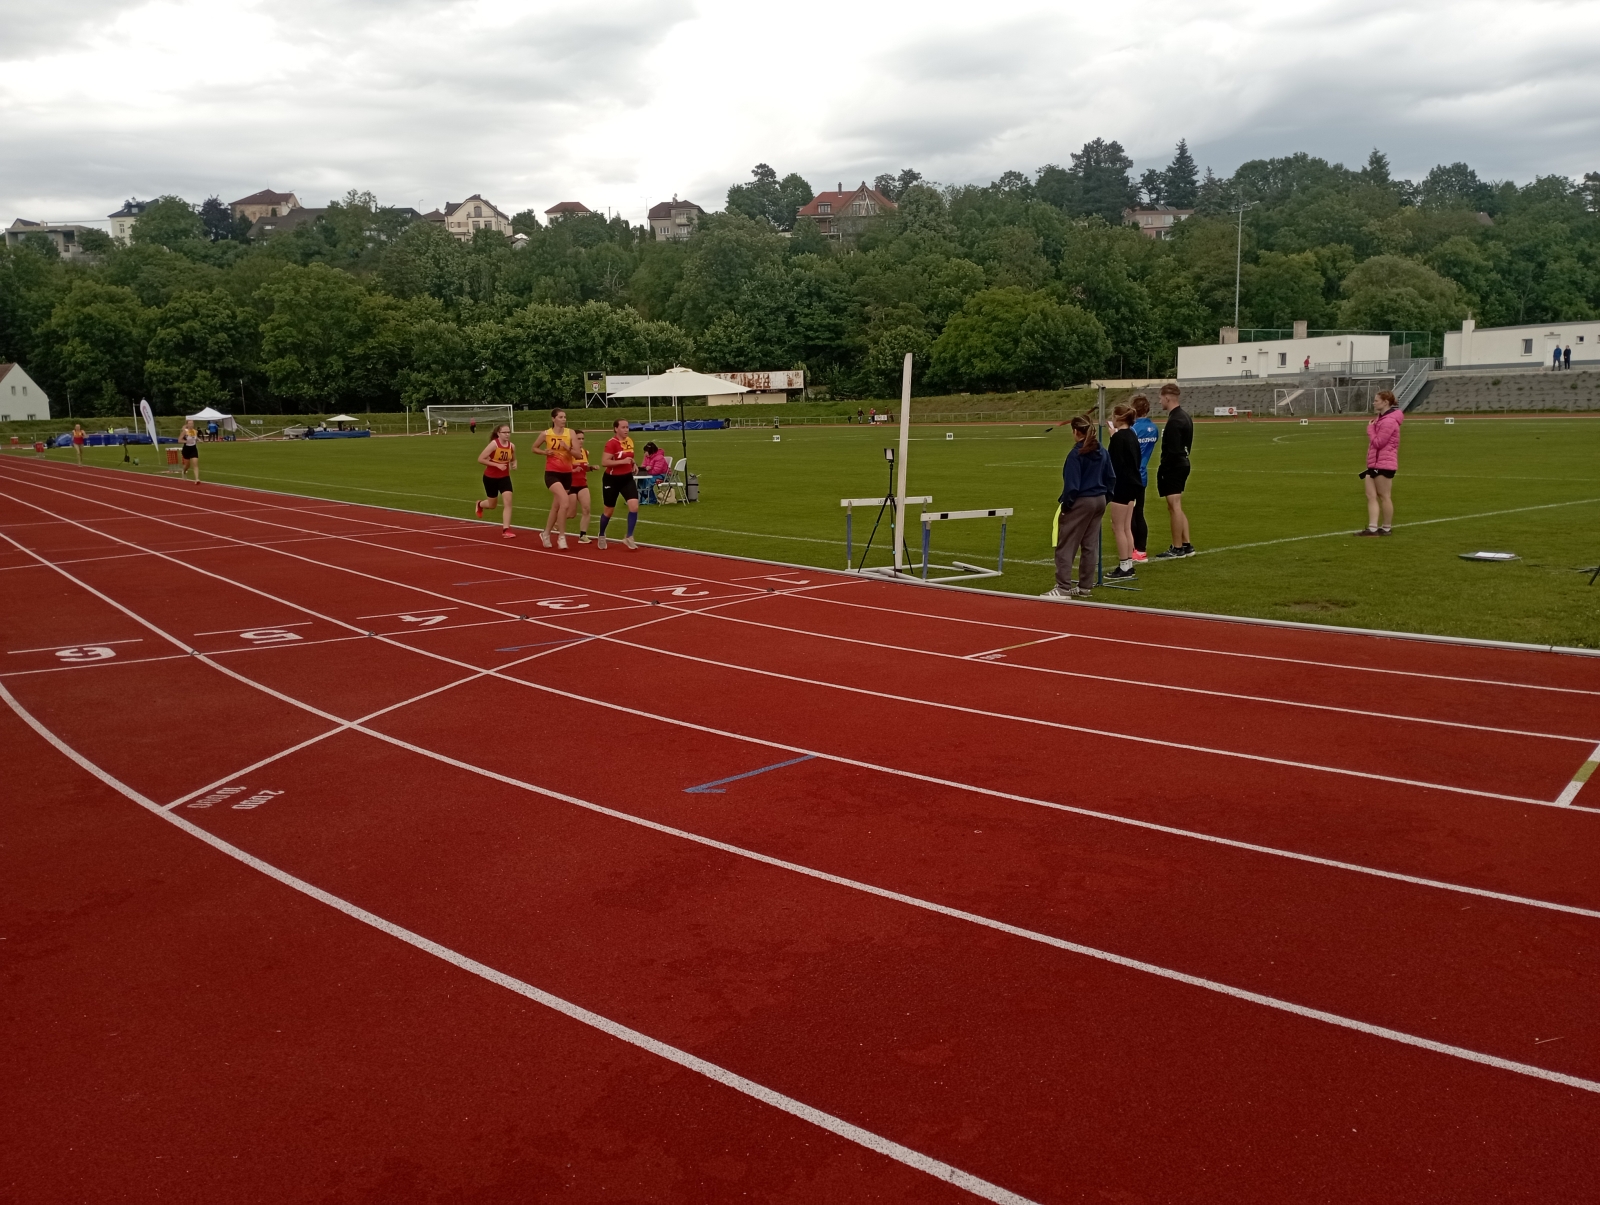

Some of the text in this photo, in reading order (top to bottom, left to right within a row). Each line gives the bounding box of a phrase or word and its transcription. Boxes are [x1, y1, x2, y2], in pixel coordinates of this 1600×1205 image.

[499, 450, 509, 461] 30
[765, 577, 811, 585] 1
[651, 586, 710, 597] 2
[536, 599, 591, 610] 3
[398, 615, 449, 627] 4
[239, 629, 304, 645] 5
